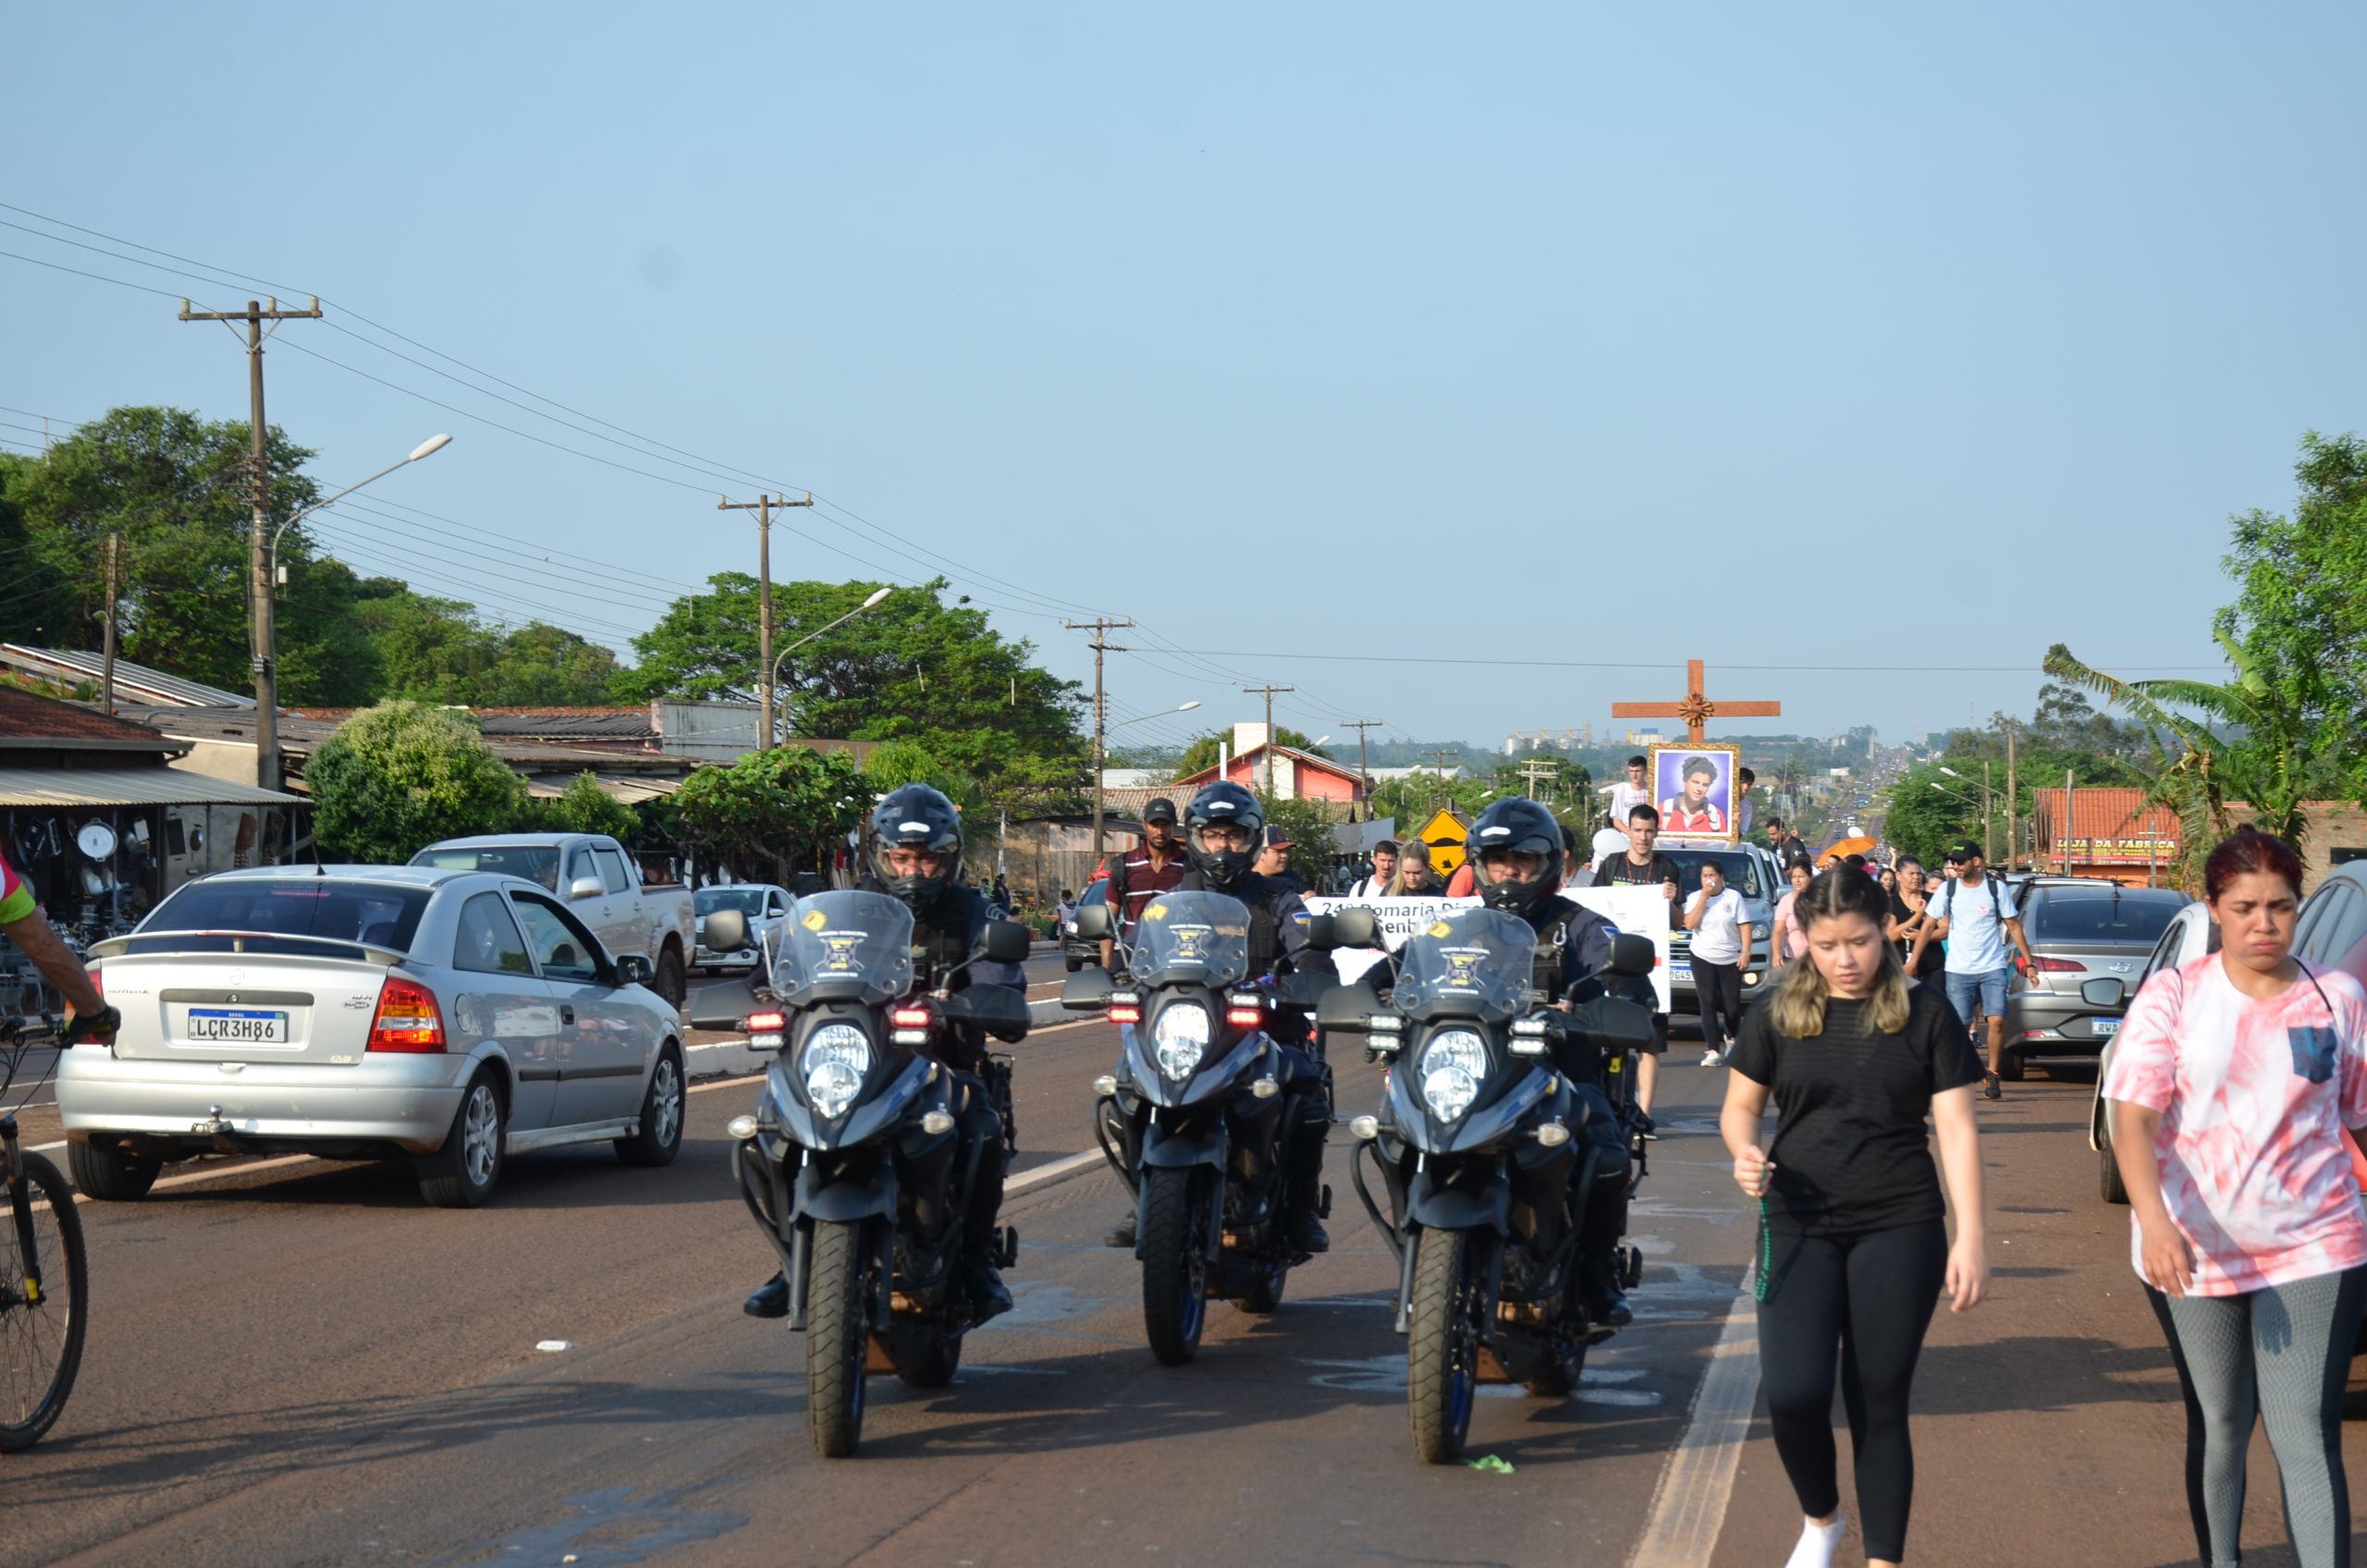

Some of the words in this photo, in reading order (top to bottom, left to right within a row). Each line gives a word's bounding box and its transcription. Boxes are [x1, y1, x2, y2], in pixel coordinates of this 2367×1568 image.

[2056, 839, 2089, 848] LJA
[2094, 839, 2112, 848] DA
[197, 1019, 275, 1038] LCR3H86
